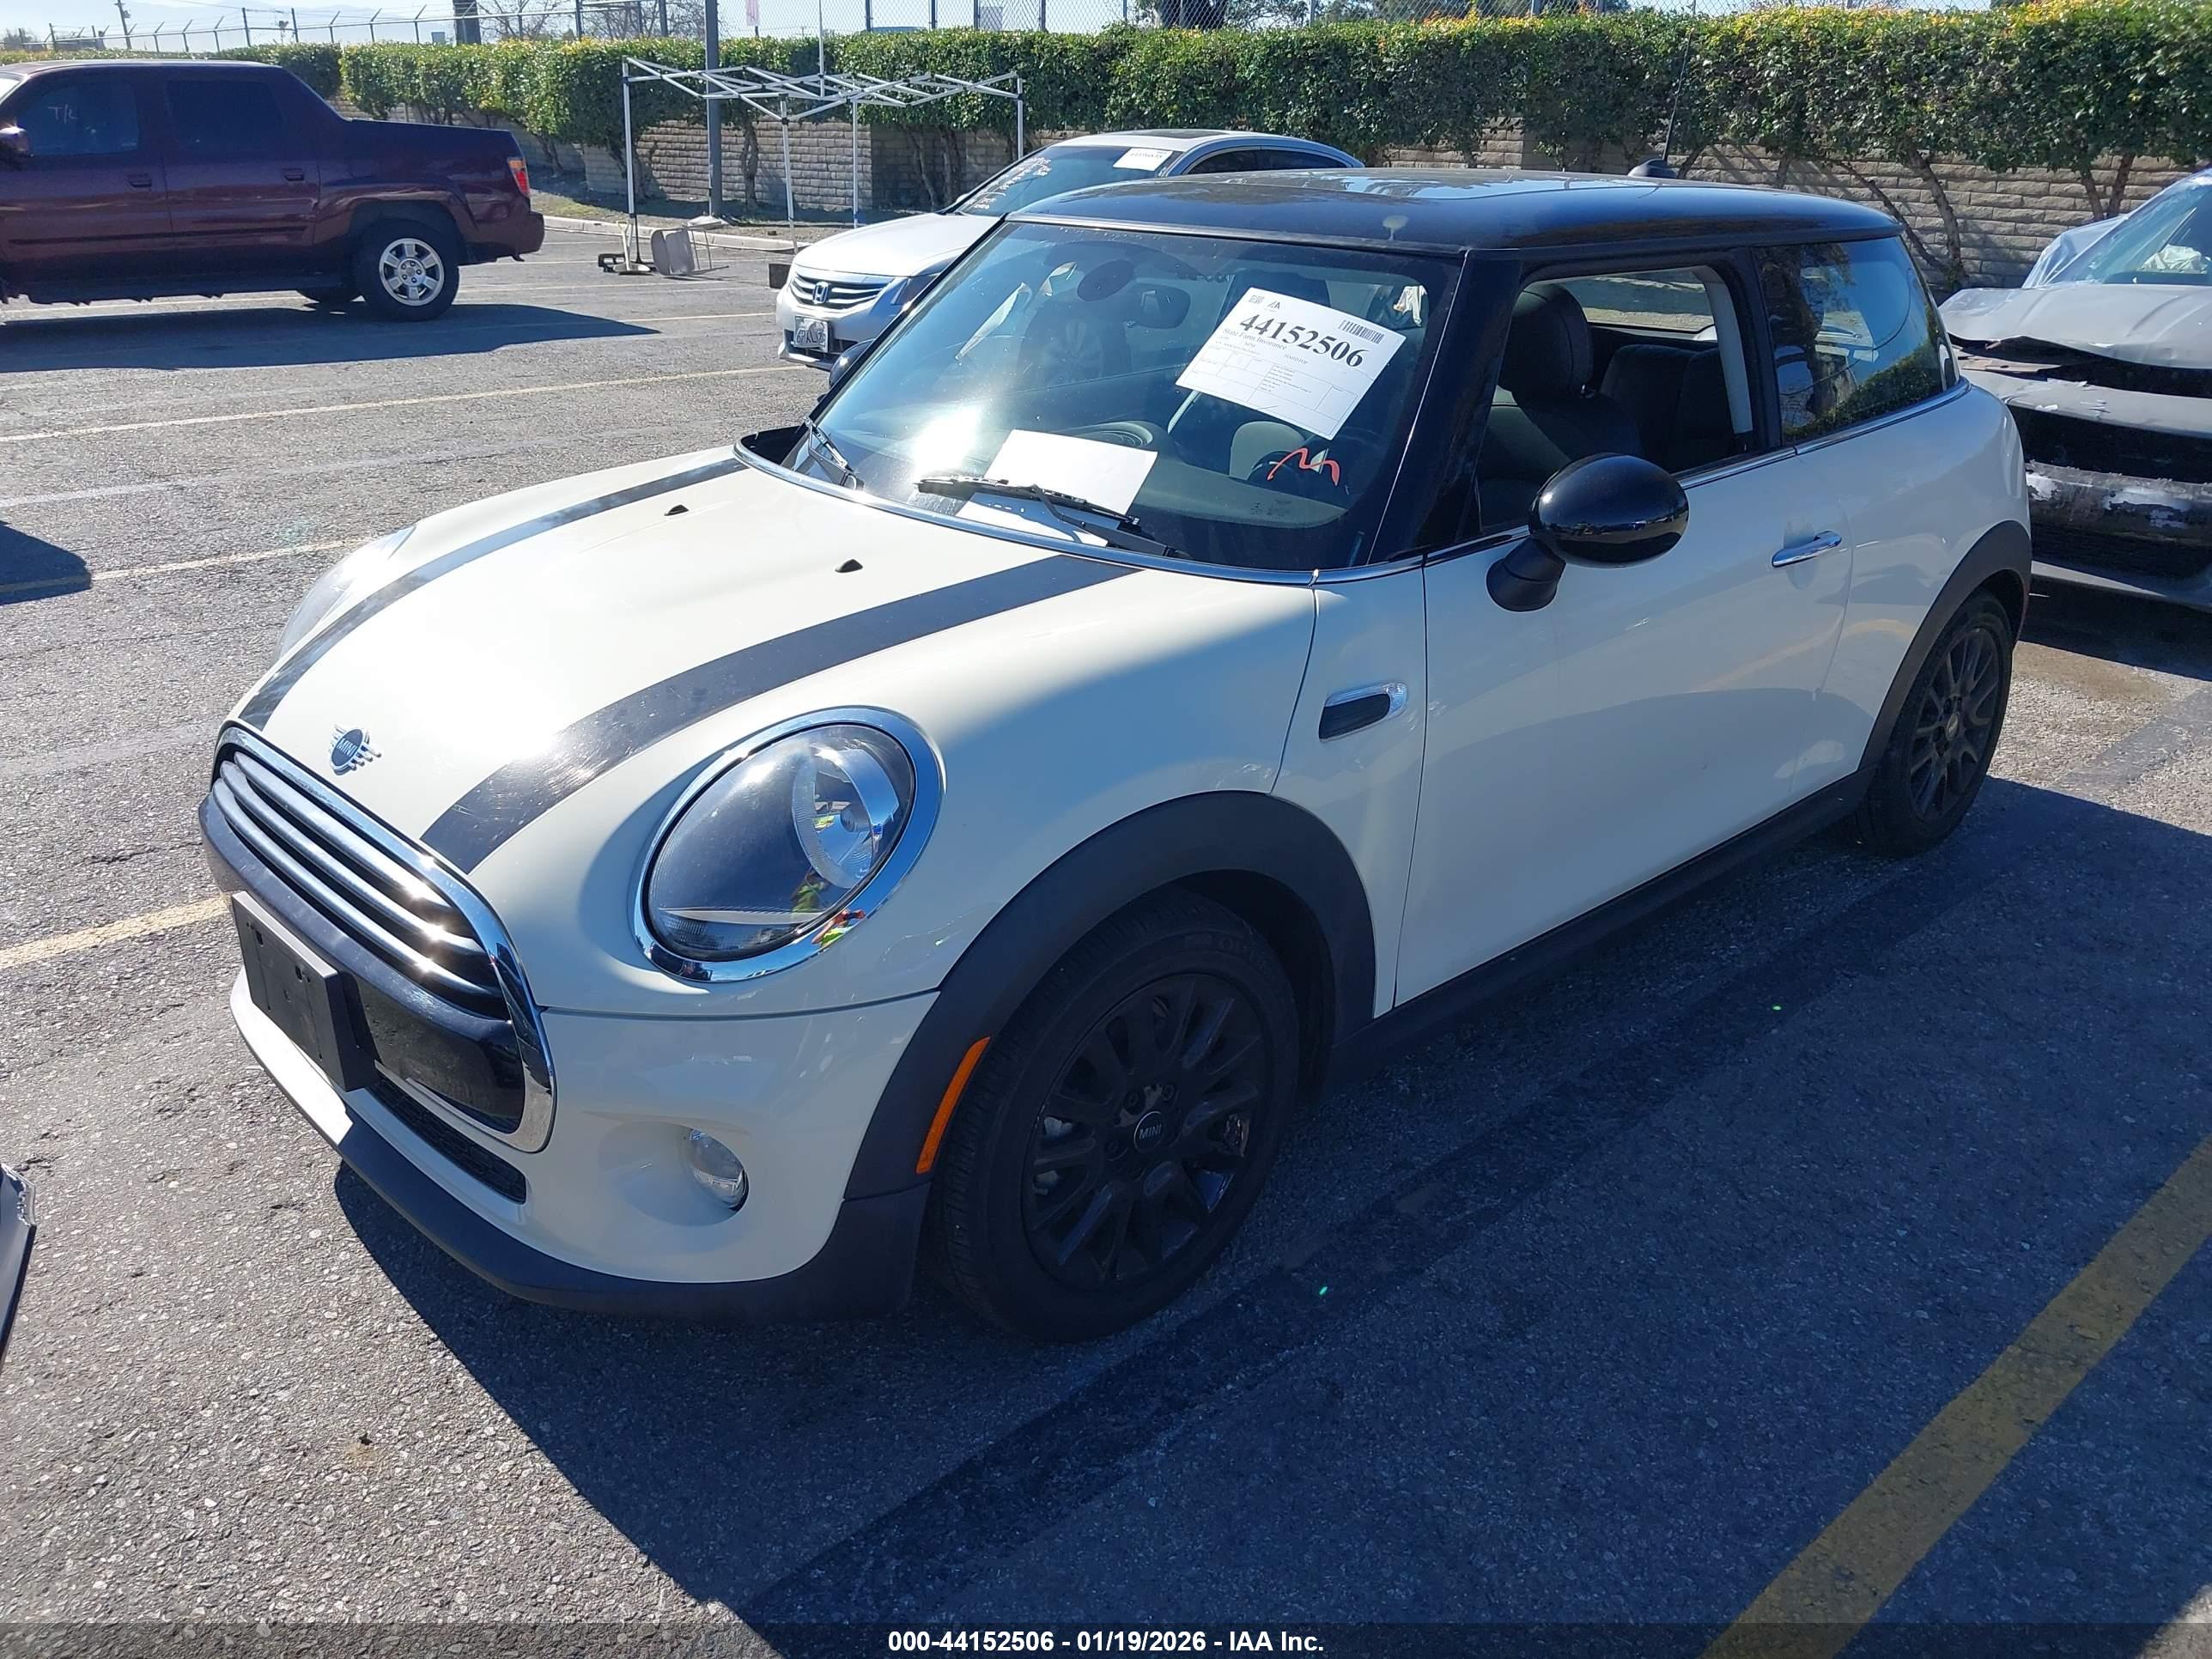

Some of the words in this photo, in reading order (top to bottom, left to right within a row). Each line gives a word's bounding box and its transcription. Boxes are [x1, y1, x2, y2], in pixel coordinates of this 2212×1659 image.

[1240, 314, 1370, 368] 44152506
[336, 738, 358, 757] MINI
[1139, 1123, 1162, 1141] MINI
